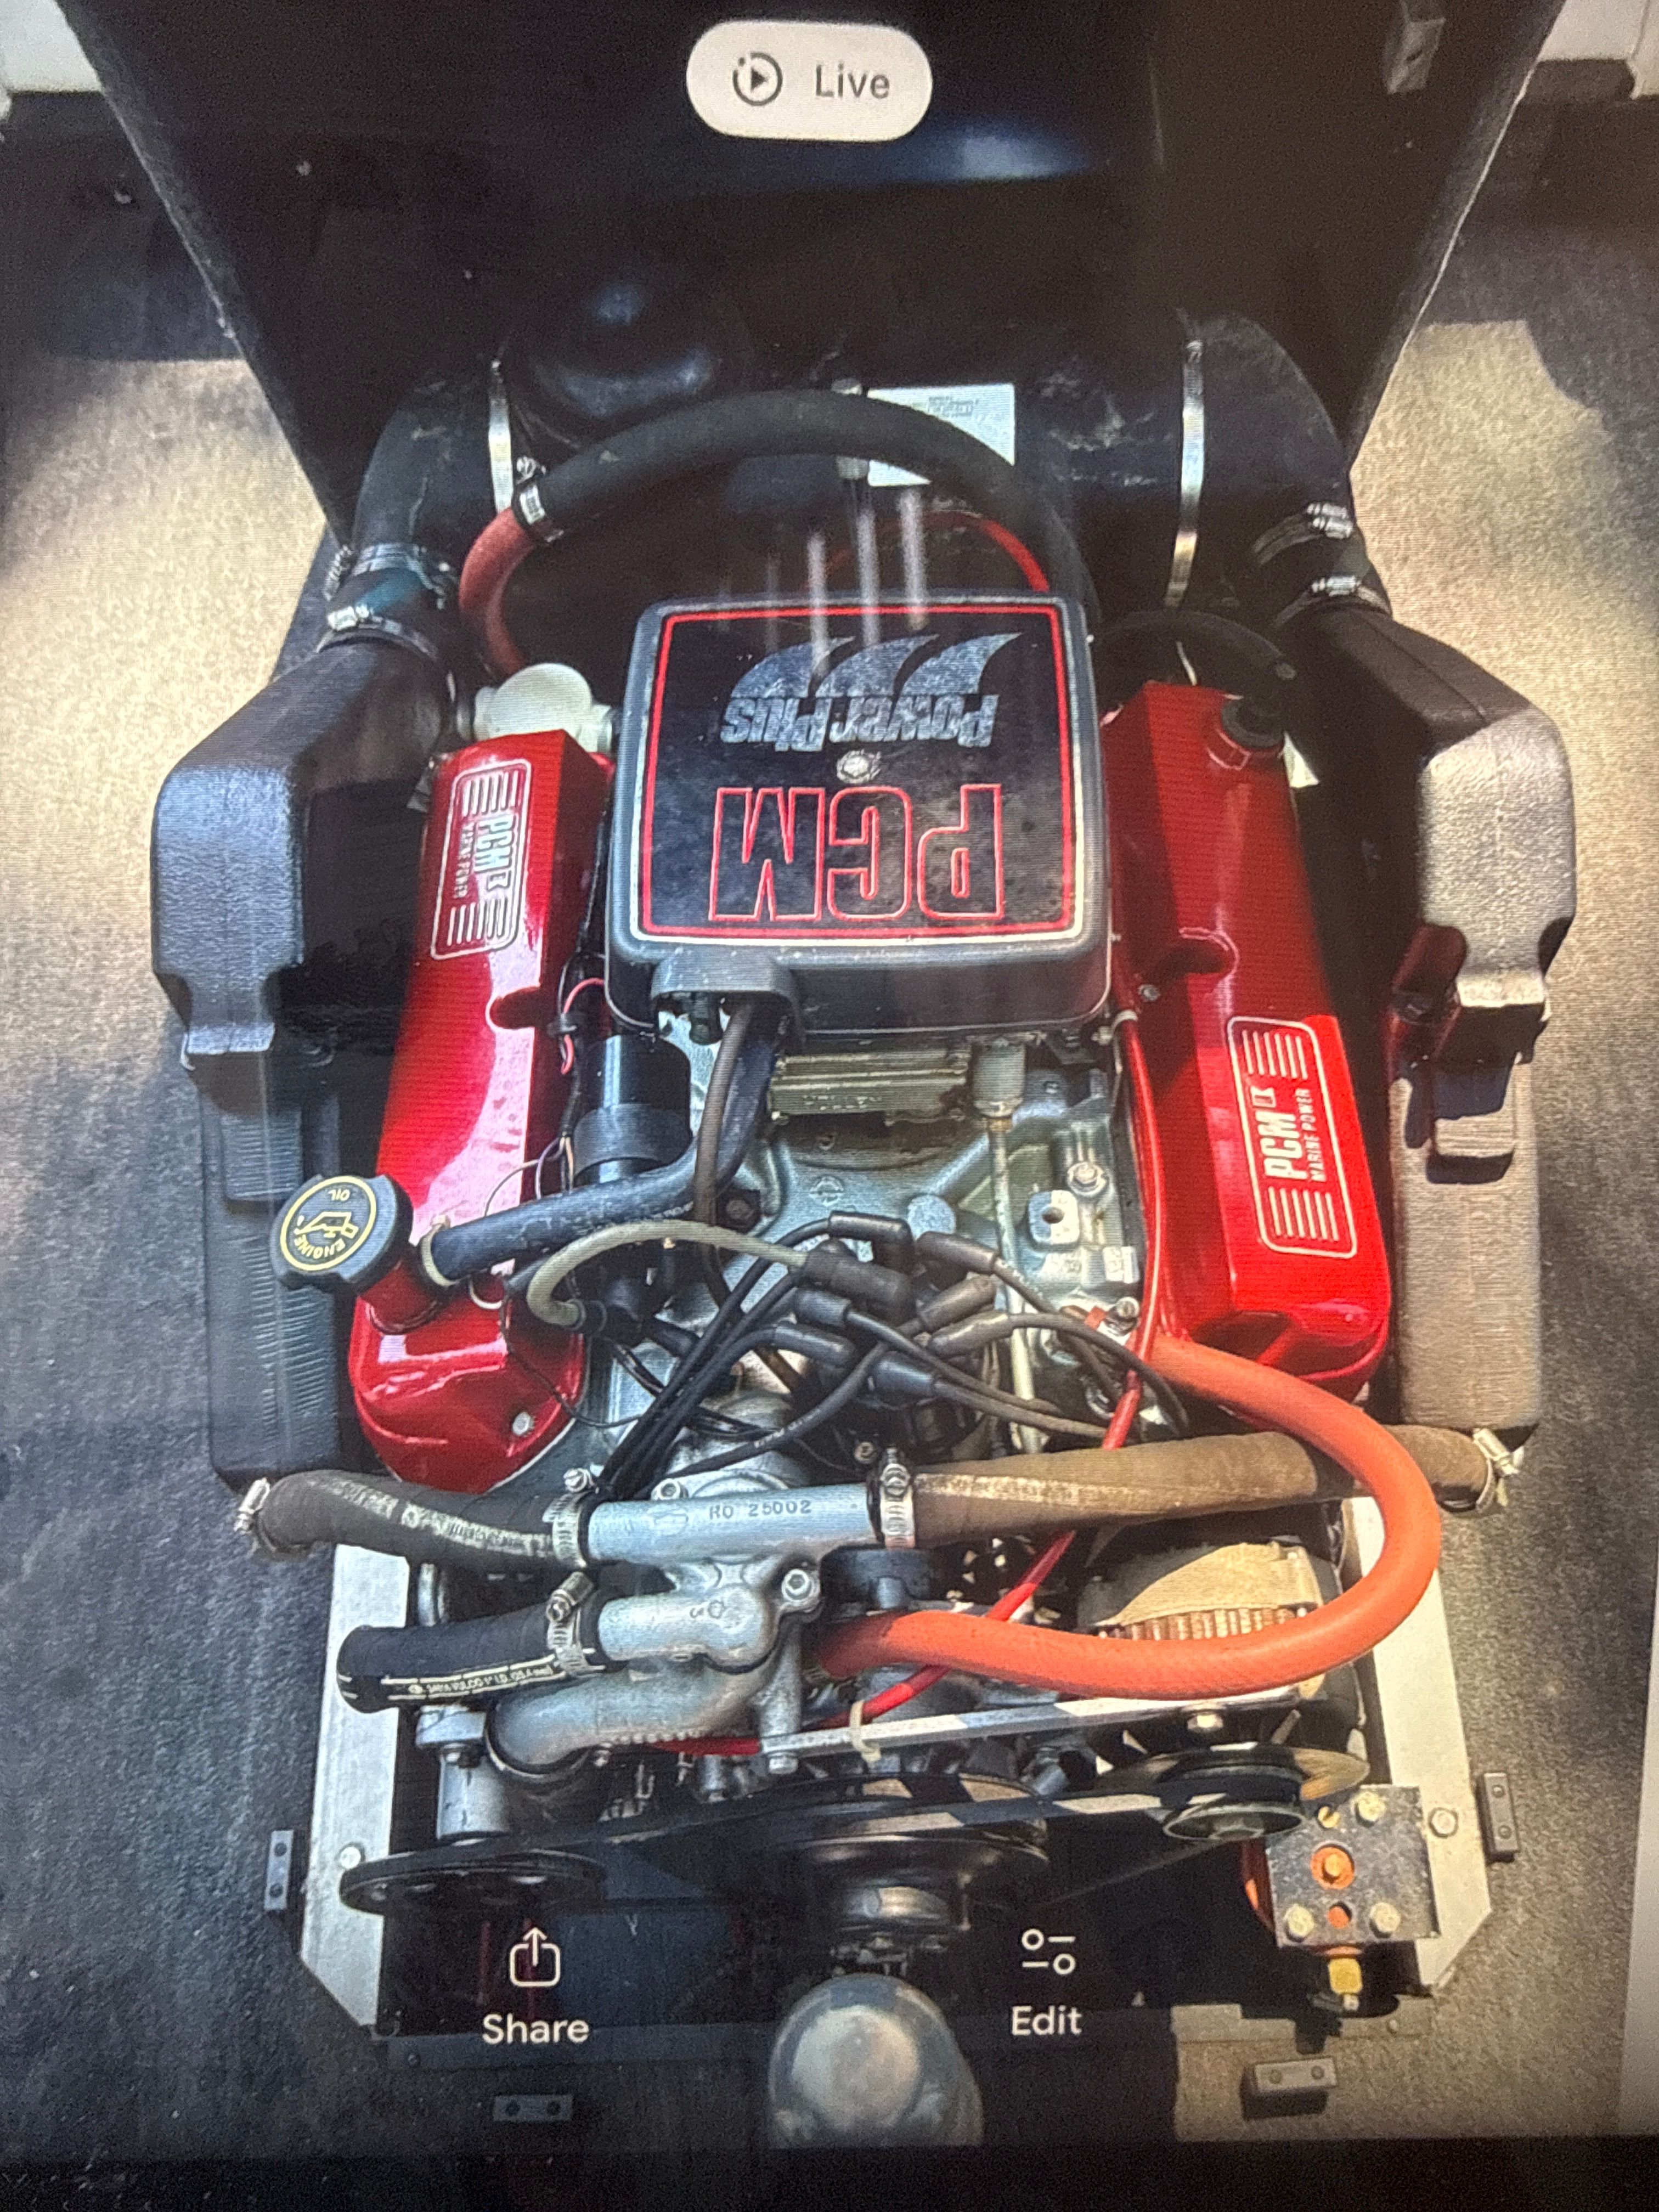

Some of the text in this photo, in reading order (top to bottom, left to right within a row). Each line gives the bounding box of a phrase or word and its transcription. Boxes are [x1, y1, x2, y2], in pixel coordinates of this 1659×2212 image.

[815, 63, 890, 100] Live
[473, 815, 514, 873] PCM
[708, 783, 1005, 922] PCM
[1255, 1111, 1308, 1180] PCM
[1295, 1088, 1326, 1182] MARINE POWER
[328, 1189, 350, 1201] OIL
[294, 1234, 346, 1259] ENGINE
[748, 1500, 811, 1517] 25002
[482, 2013, 590, 2045] Share
[1011, 2006, 1082, 2036] Edit
